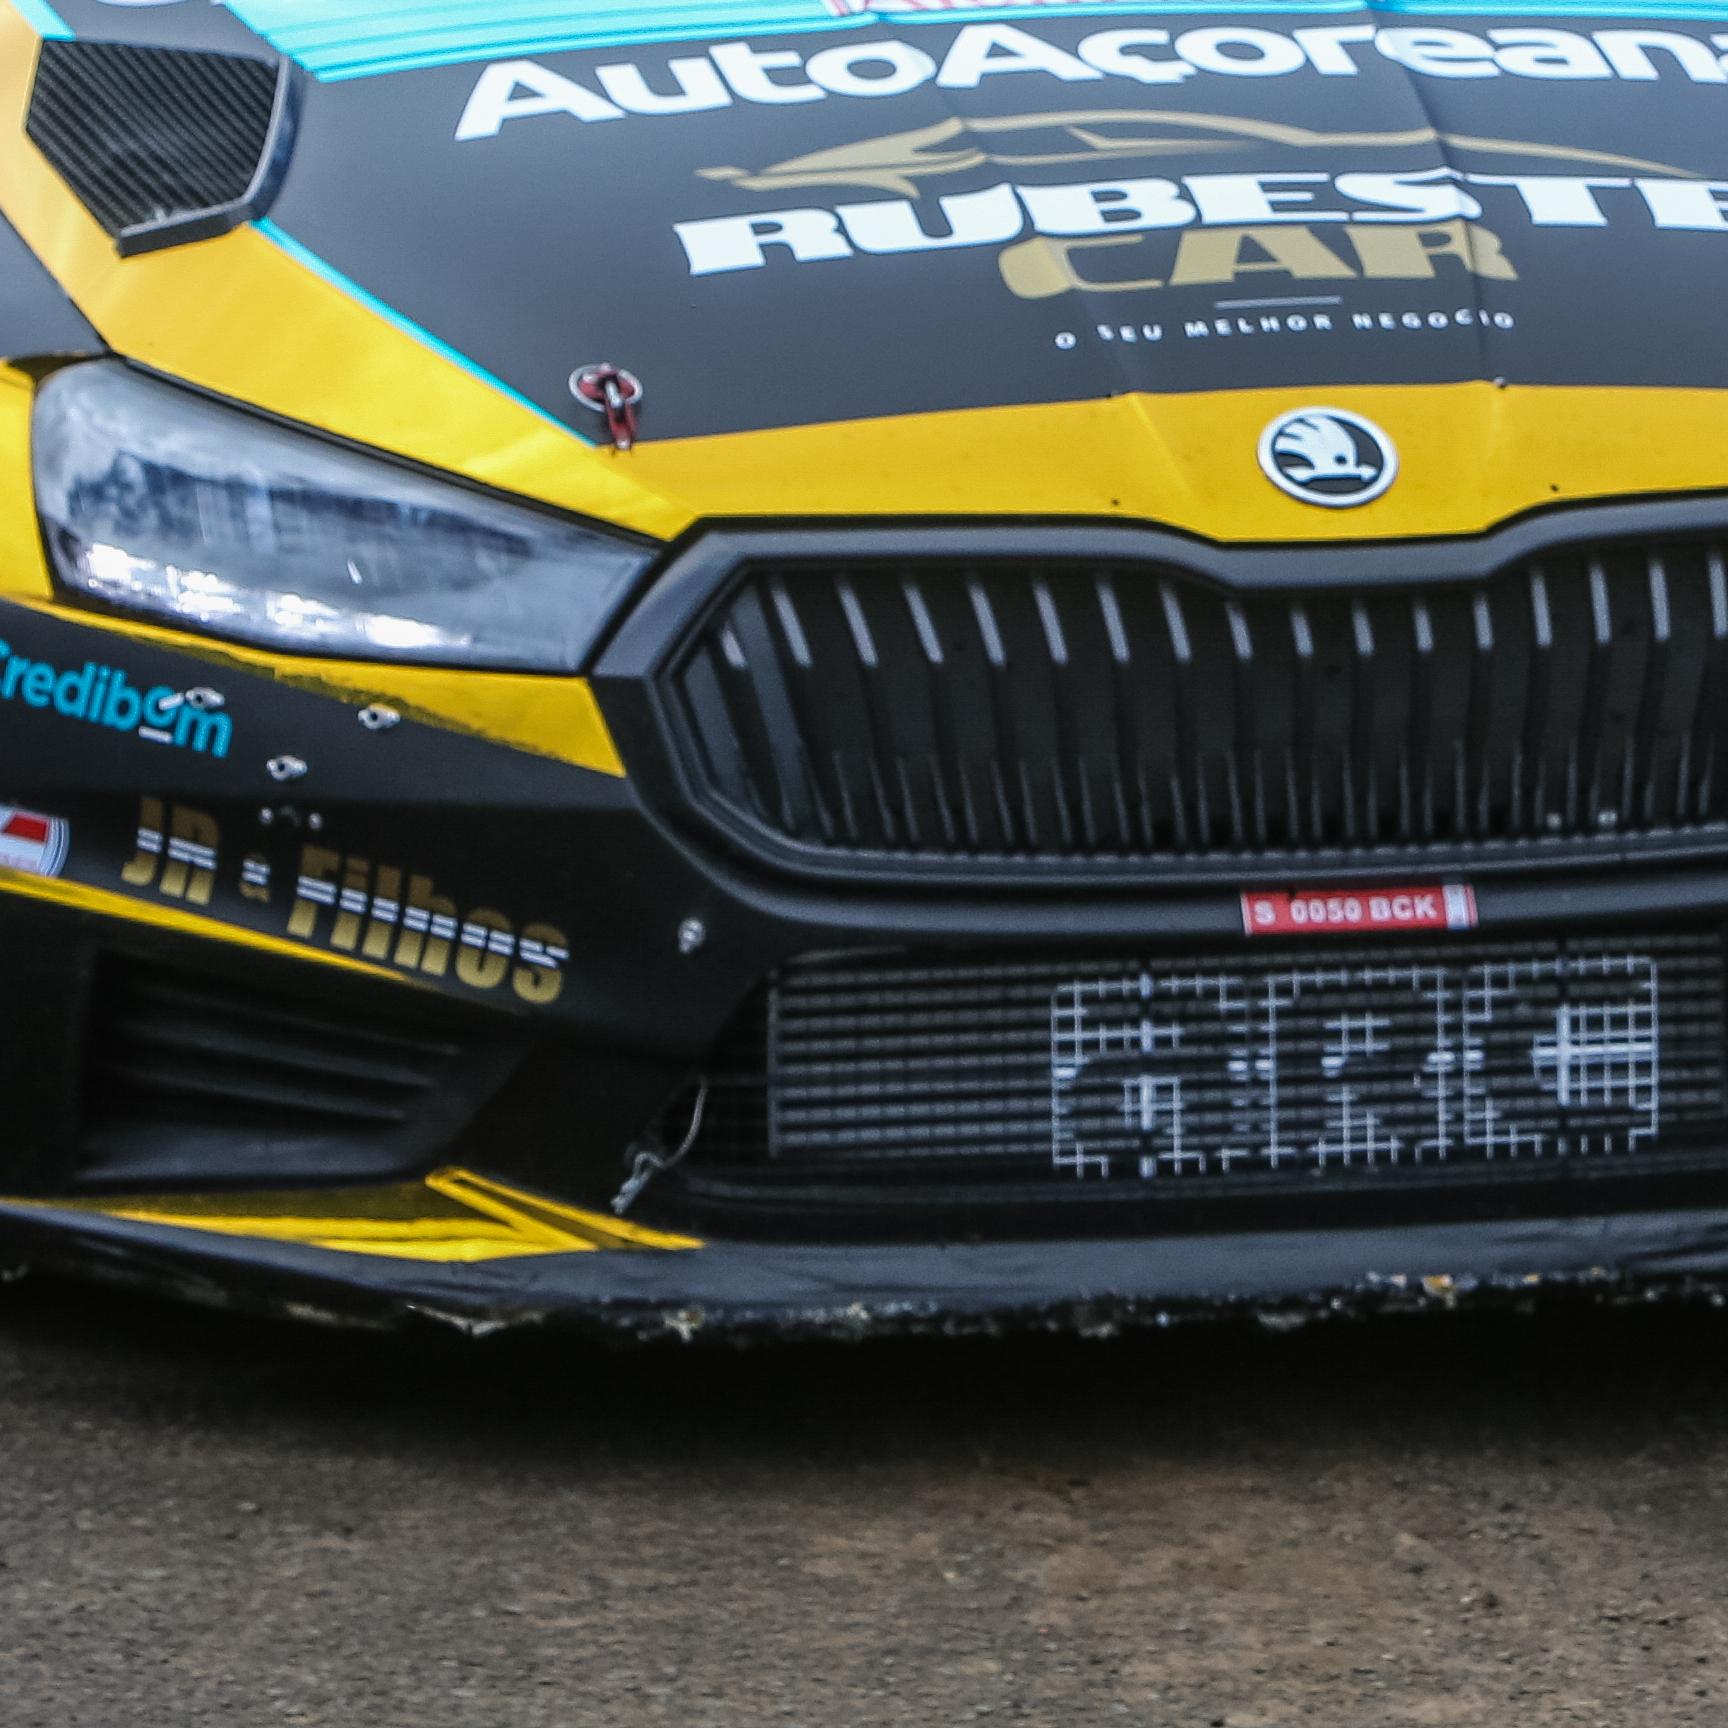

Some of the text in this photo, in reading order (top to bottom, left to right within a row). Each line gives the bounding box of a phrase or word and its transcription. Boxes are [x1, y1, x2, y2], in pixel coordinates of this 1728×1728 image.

[998, 222, 1518, 300] CAR
[1053, 330, 1077, 350] O
[1096, 322, 1163, 343] SEU
[1183, 312, 1334, 339] MELHOR
[1252, 899, 1276, 925] S
[1368, 893, 1438, 922] BCK
